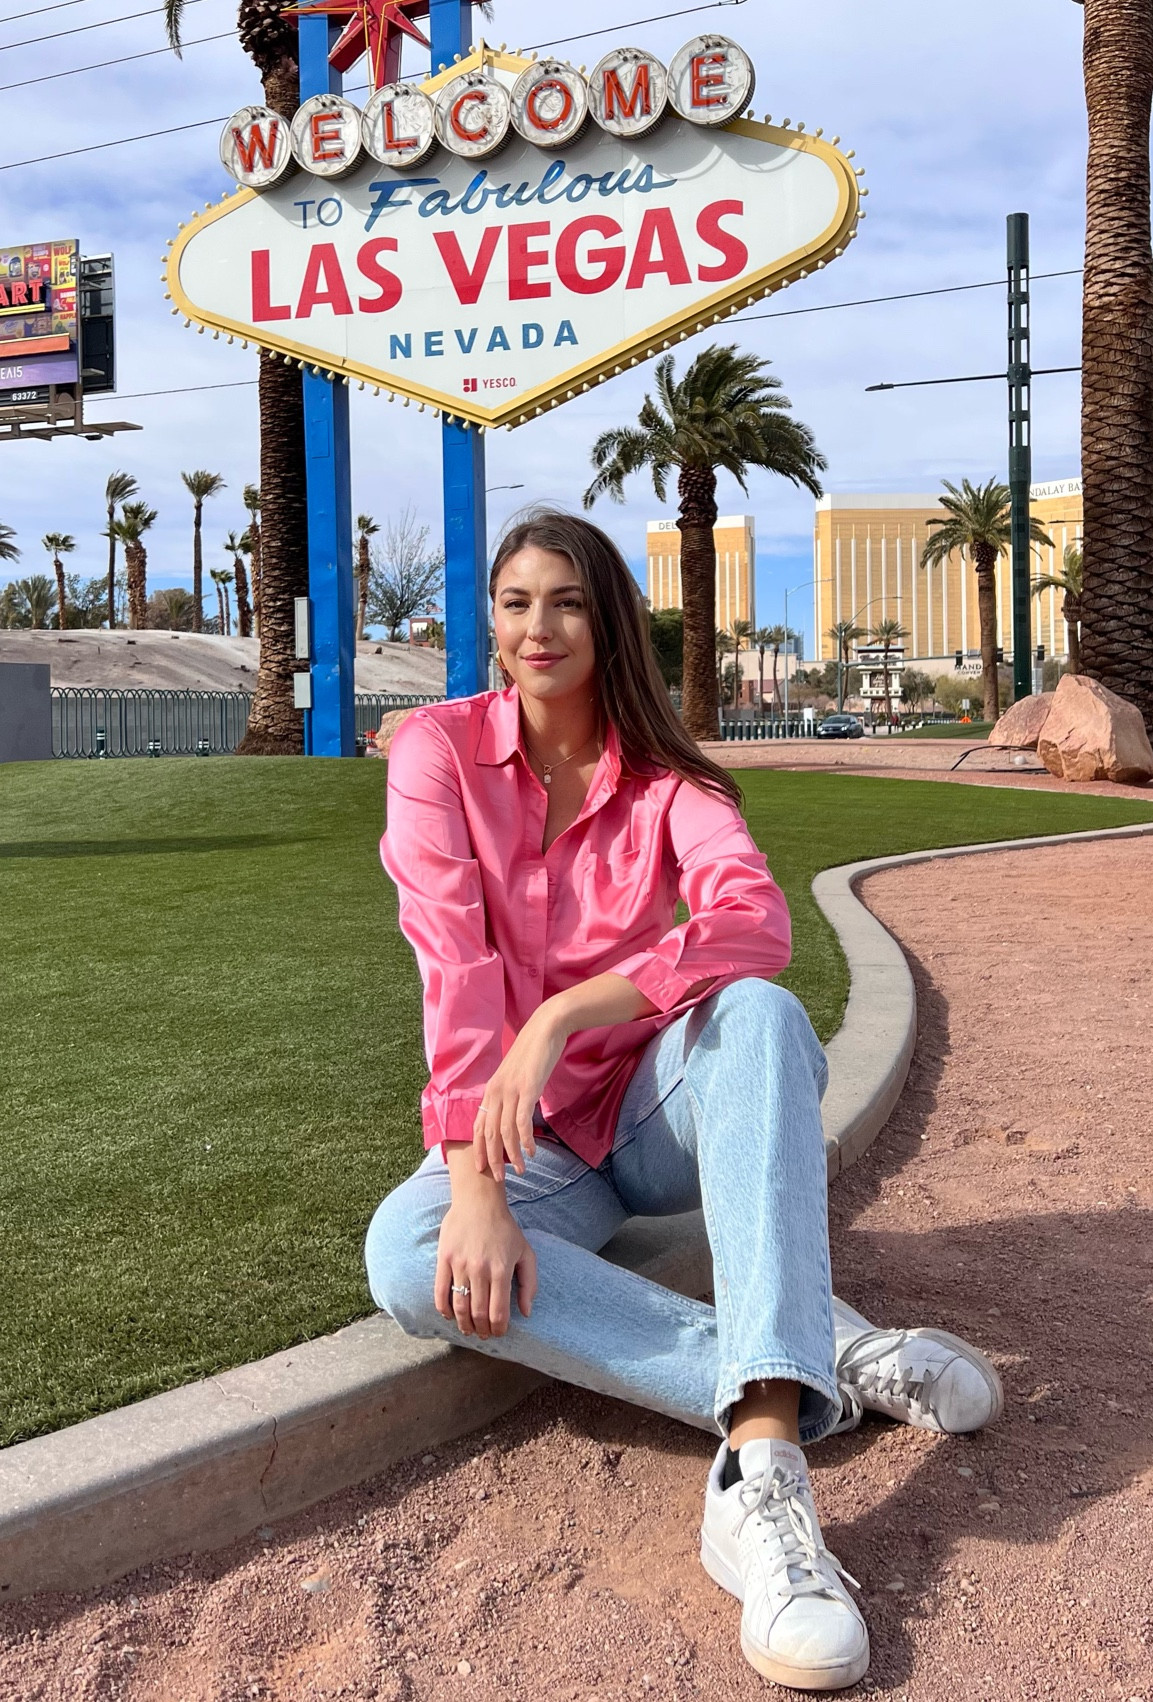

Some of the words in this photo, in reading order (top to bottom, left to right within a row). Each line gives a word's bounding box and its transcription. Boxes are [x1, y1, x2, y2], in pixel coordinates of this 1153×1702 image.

[231, 53, 728, 173] WELCOME
[294, 197, 343, 229] TO
[364, 160, 678, 232] Fabulous
[251, 236, 403, 322] LAS
[432, 199, 749, 305] VEGAS
[390, 320, 579, 359] NEVADA
[482, 377, 516, 389] YESCO
[12, 391, 37, 401] 63372
[1029, 484, 1065, 497] NDALAY
[658, 521, 678, 531] DEL
[955, 663, 983, 671] MAND
